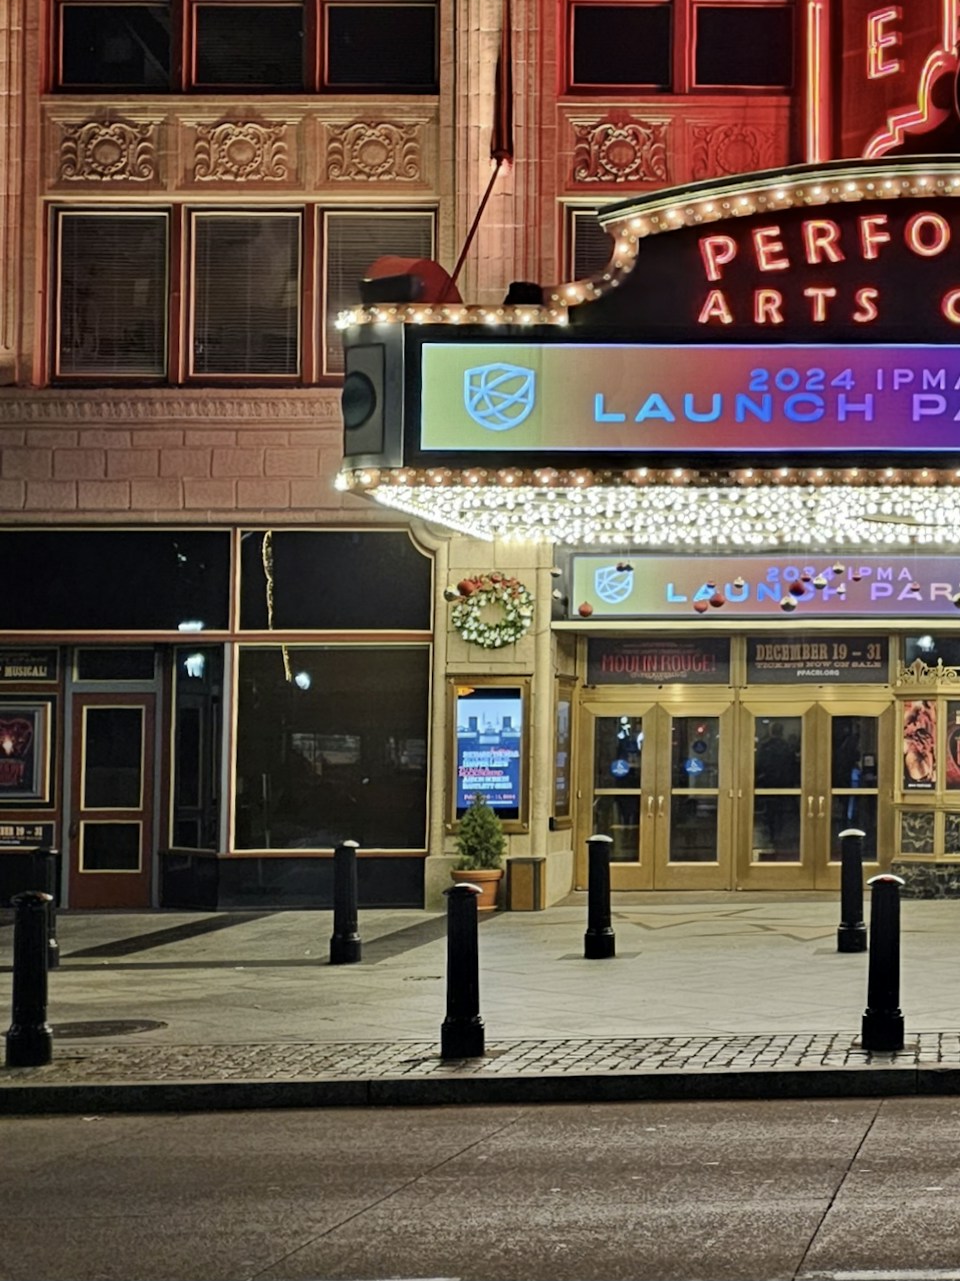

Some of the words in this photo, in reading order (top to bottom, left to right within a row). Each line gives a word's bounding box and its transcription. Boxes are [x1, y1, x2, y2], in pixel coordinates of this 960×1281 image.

[698, 287, 879, 324] ARTS
[749, 367, 856, 392] 2024
[594, 392, 874, 423] LAUNCH
[847, 566, 913, 581] IPMA
[756, 643, 828, 661] DECEMBER
[832, 643, 848, 660] 19
[867, 643, 882, 660] 31
[601, 654, 658, 673] MOULIN
[660, 654, 717, 673] ROUGE!
